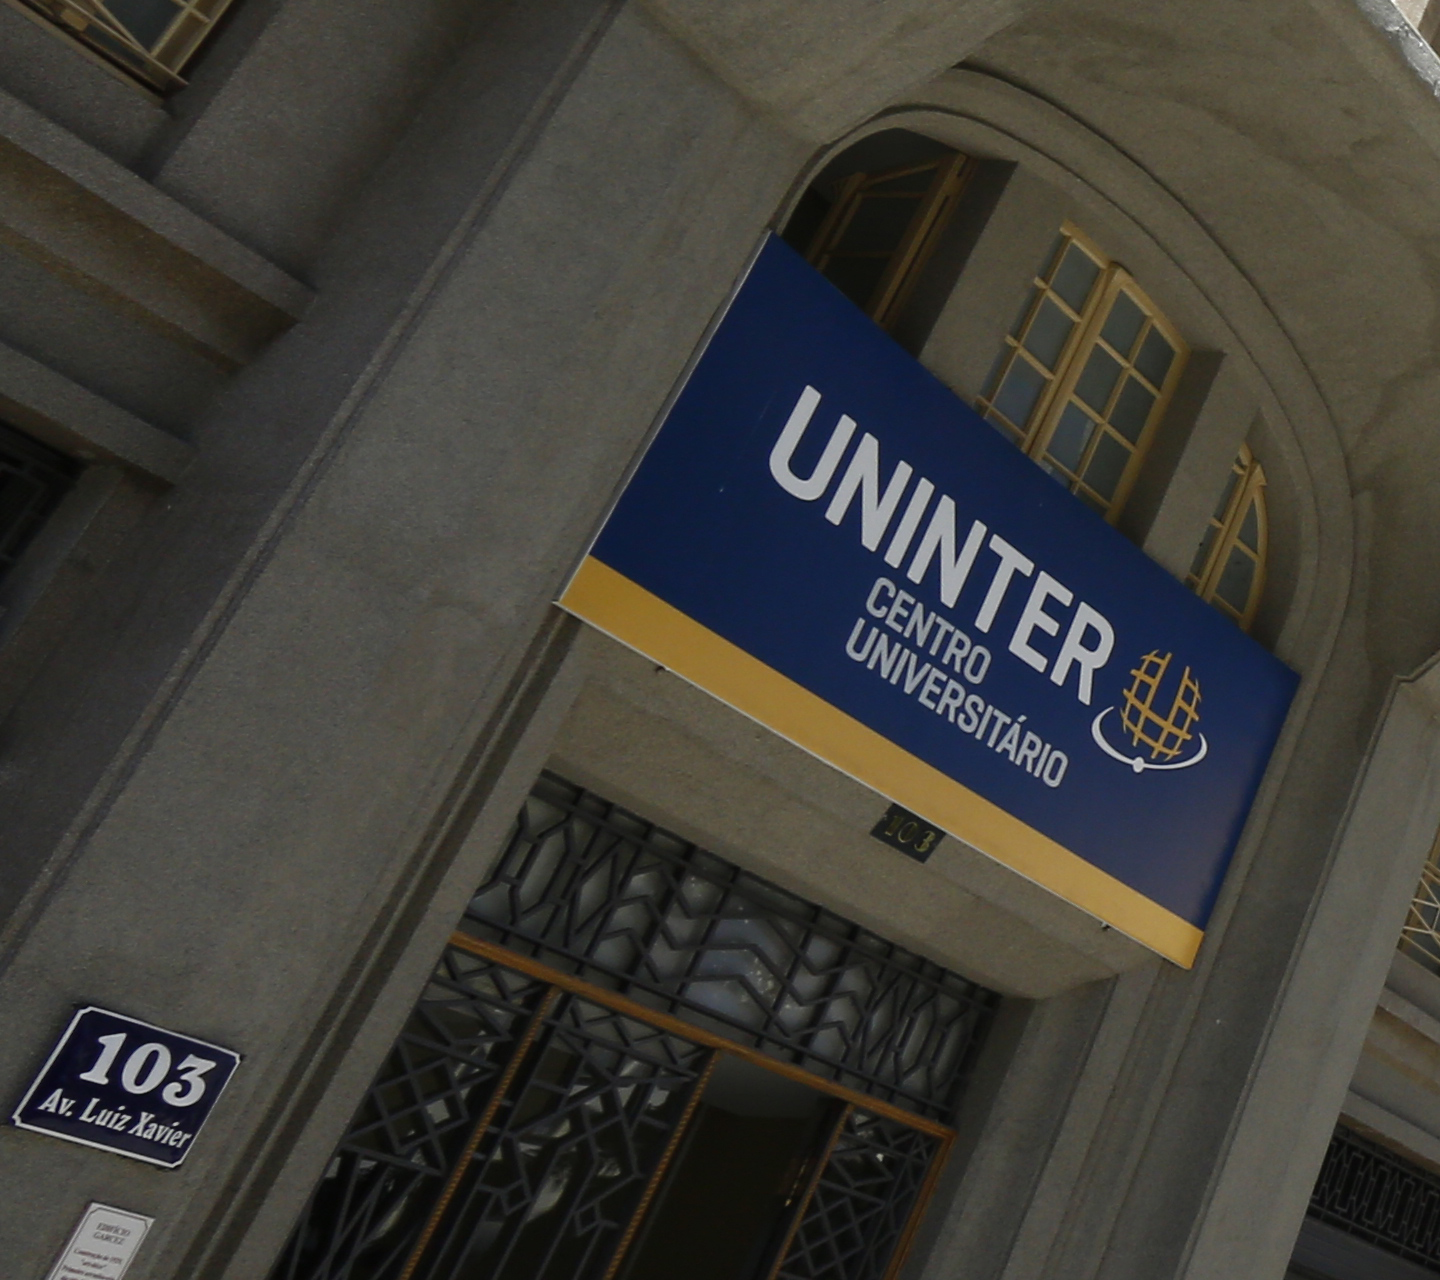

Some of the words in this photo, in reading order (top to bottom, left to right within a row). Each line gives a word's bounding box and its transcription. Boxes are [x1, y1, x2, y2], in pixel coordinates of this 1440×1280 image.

[769, 384, 1115, 706] UNINTER
[866, 576, 991, 685] CENTRO
[845, 617, 1068, 789] UNIVERSITÁRIO
[884, 815, 936, 853] 103
[79, 1032, 217, 1107] 103
[38, 1088, 74, 1118] Av.
[81, 1098, 132, 1133] Luiz
[129, 1111, 193, 1149] Xavier
